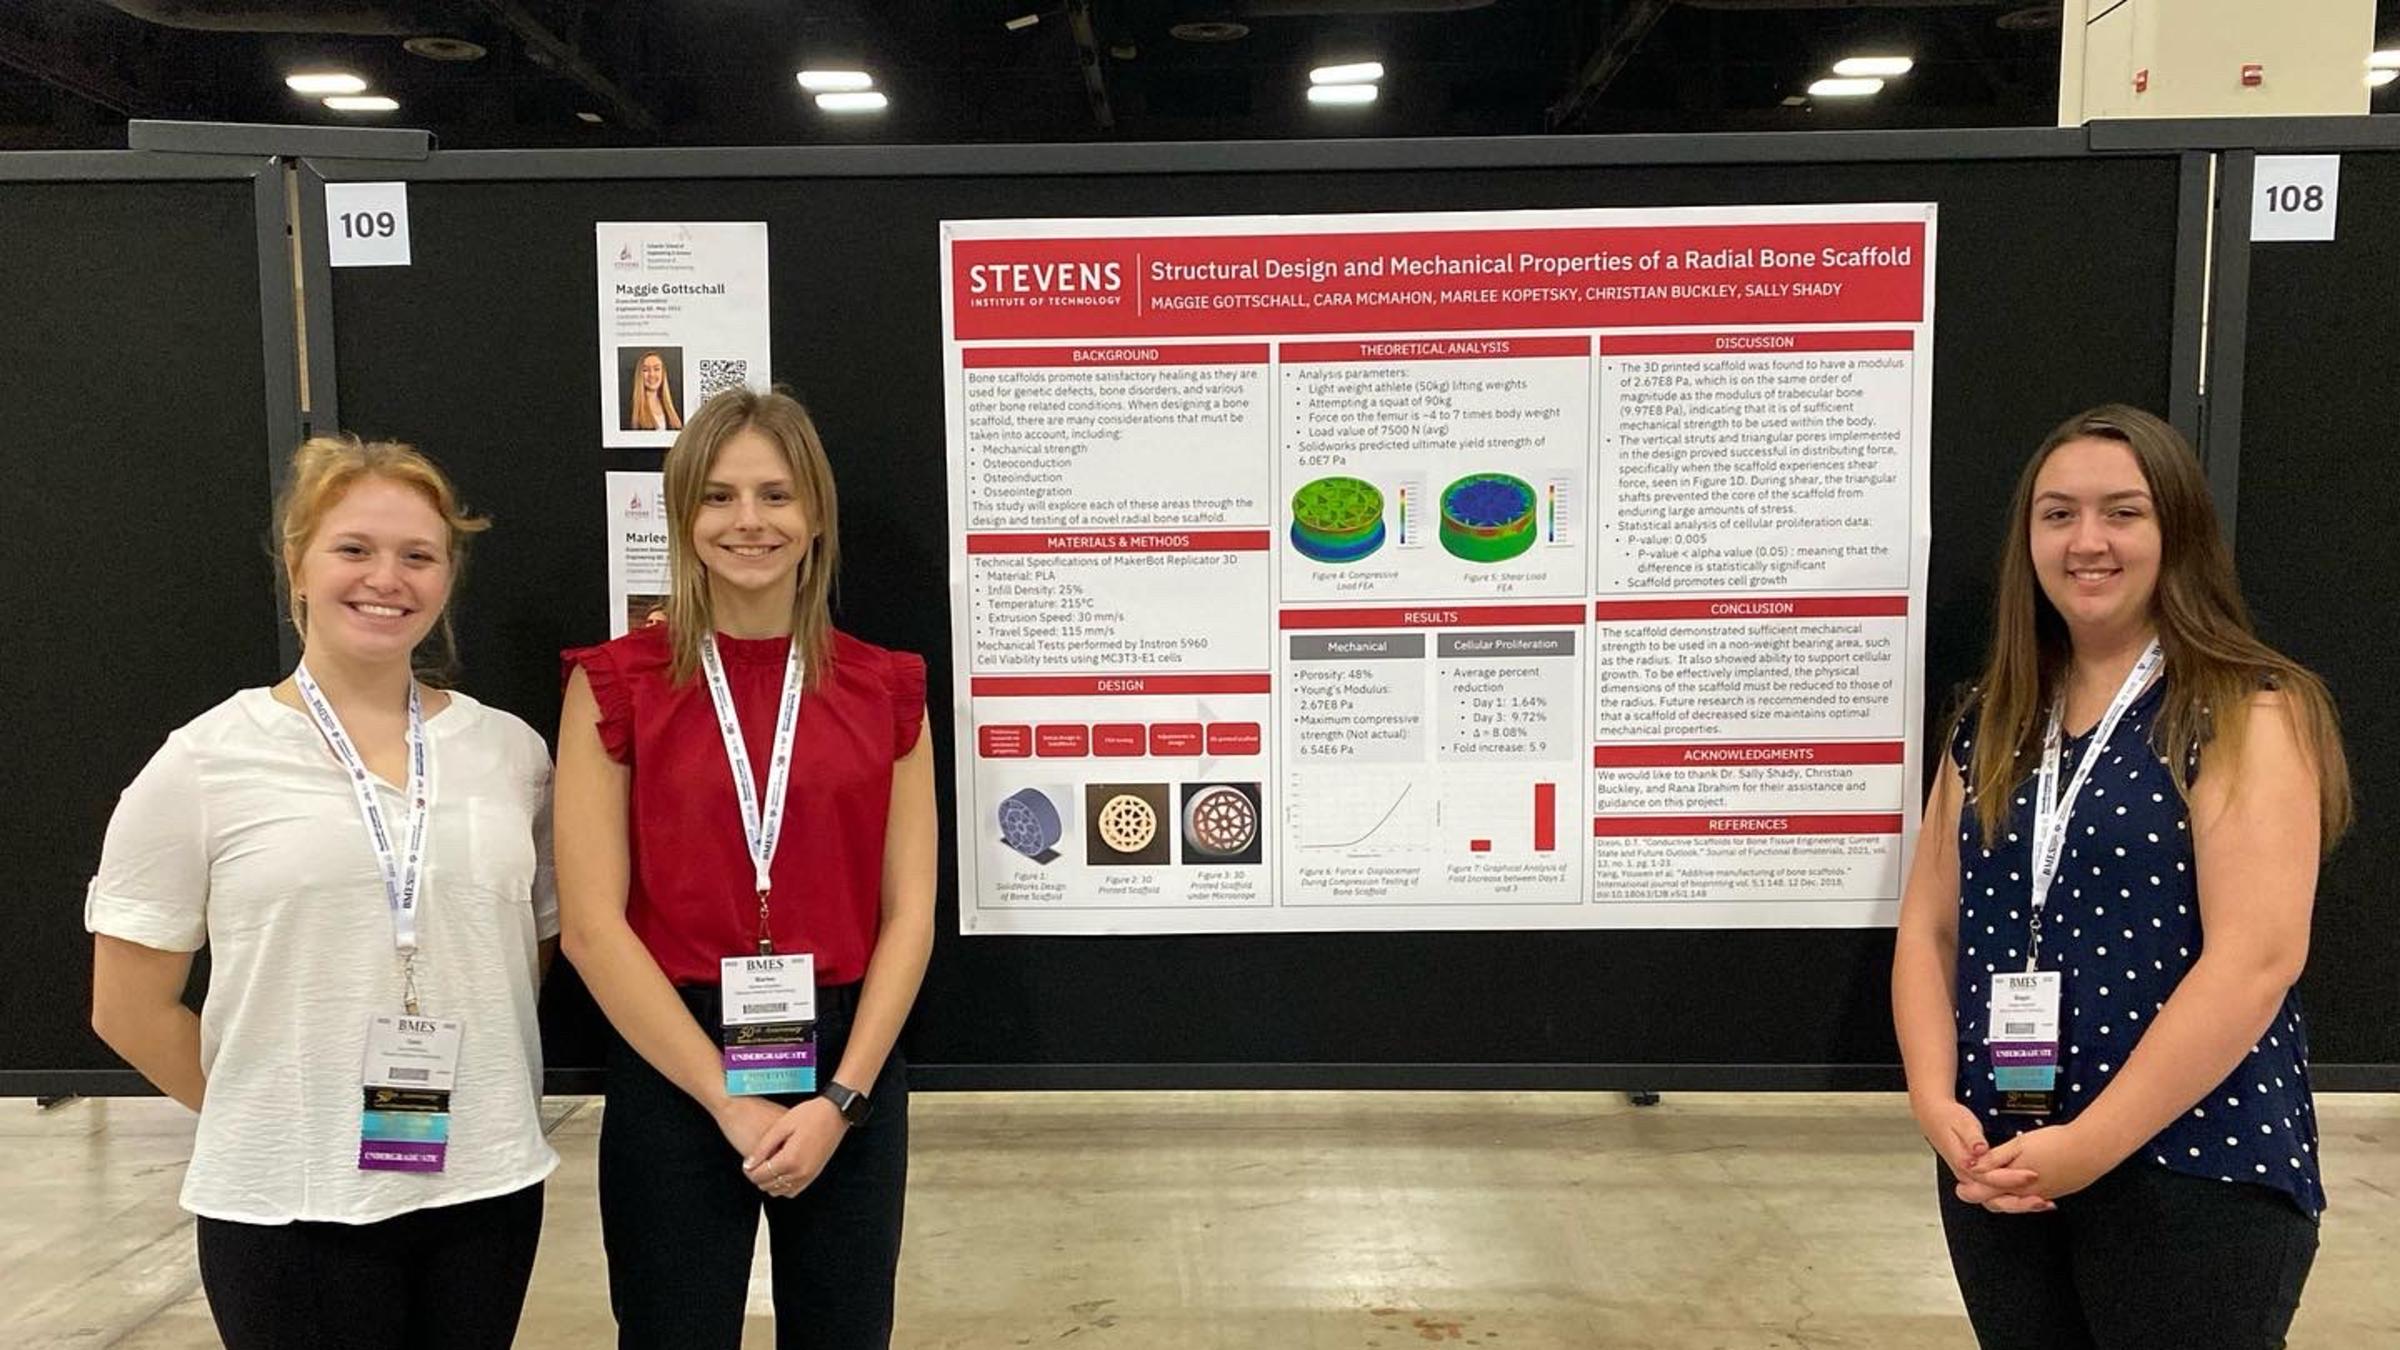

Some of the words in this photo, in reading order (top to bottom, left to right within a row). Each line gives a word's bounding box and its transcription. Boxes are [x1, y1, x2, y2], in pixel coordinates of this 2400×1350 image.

[2266, 185, 2323, 212] 108
[340, 211, 395, 238] 109
[1151, 260, 1258, 281] Structural
[1265, 258, 1337, 284] Design
[1344, 257, 1384, 276] and
[1391, 254, 1512, 275] Mechanical
[1520, 252, 1632, 278] Properties
[1639, 251, 1660, 270] of
[1666, 255, 1678, 269] a
[1685, 249, 1753, 269] Radial
[1760, 247, 1815, 267] Bone
[1822, 245, 1911, 266] Scaffold
[971, 261, 1120, 294] STEVENS
[616, 283, 659, 297] Maggie
[662, 283, 725, 294] Gottschall
[971, 297, 1025, 307] INSTITUTE
[1029, 297, 1044, 306] OF
[1049, 296, 1121, 306] TECHNOLOGY
[1151, 295, 1209, 309] MAGGIE
[1213, 293, 1311, 310] GOTTSCHALL,
[1313, 292, 1352, 306] CARA
[1356, 290, 1437, 308] MCMAHON,
[1440, 289, 1498, 304] MARLEE
[1502, 288, 1583, 305] KOPETSKY,
[1586, 286, 1668, 301] CHRISTIAN
[1671, 285, 1742, 302] BUCKLEY,
[1745, 284, 1788, 298] SALLY
[1792, 283, 1842, 297] SHADY
[1361, 344, 1443, 355] THEORETICAL
[1448, 342, 1510, 353] ANALYSIS
[1715, 337, 1794, 348] DISCUSSION
[1073, 350, 1159, 361] BACKGROUND
[1299, 369, 1343, 381] Analysis
[1345, 368, 1410, 381] parameters:
[1308, 383, 1334, 395] Light
[1337, 382, 1373, 395] weight
[1374, 382, 1413, 392] athlete
[1415, 381, 1450, 394] (50kg)
[1452, 381, 1483, 393] lifting
[1485, 380, 1527, 392] weights
[982, 444, 1042, 454] Mechanical
[1044, 444, 1088, 456] strength
[982, 458, 1072, 468] Osteoconduction
[1332, 455, 1346, 465] Pa
[983, 472, 1063, 482] Osteoinduction
[983, 486, 1072, 499] Osseointegration
[625, 532, 667, 543] Marlee
[1047, 537, 1116, 548] MATERIALS
[1119, 537, 1128, 547] &
[1130, 536, 1189, 547] METHODS
[1628, 534, 1673, 544] P-value:
[1674, 534, 1707, 544] 0.005
[975, 557, 1025, 567] Technical
[1026, 556, 1099, 569] Specifications
[1101, 556, 1112, 566] of
[1114, 556, 1165, 566] MakerBot
[1166, 555, 1220, 568] Replicator
[1223, 555, 1238, 565] 3D
[986, 571, 1033, 580] Material:
[1035, 570, 1056, 580] PLA
[1627, 577, 1672, 587] Scaffold
[1673, 576, 1726, 589] promotes
[1728, 576, 1748, 586] cell
[1749, 575, 1788, 588] growth
[987, 585, 1012, 594] Infill
[1014, 585, 1057, 597] Density:
[1059, 585, 1084, 594] 25%
[988, 599, 1058, 611] Temperature:
[1711, 603, 1794, 614] CONCLUSION
[988, 612, 1037, 622] Extrusion
[1039, 612, 1076, 624] Speed:
[1078, 612, 1092, 622] 30
[1094, 612, 1124, 624] mm/s
[1404, 612, 1458, 623] RESULTS
[988, 626, 1021, 636] Travel
[1023, 626, 1059, 638] Speed:
[1062, 626, 1082, 636] 115
[1084, 626, 1115, 638] mm/s
[1602, 627, 1622, 637] The
[1624, 626, 1668, 636] scaffold
[1669, 625, 1746, 636] demonstrated
[1748, 625, 1798, 635] sufficient
[1800, 624, 1863, 634] mechanical
[977, 640, 1036, 650] Mechanical
[1038, 640, 1066, 650] Tests
[1068, 640, 1123, 652] performed
[1124, 639, 1137, 651] by
[1140, 639, 1178, 649] Instron
[1180, 639, 1208, 648] 5960
[1328, 641, 1387, 652] Mechanical
[1454, 639, 1493, 649] Cellular
[1495, 639, 1558, 649] Proliferation
[977, 654, 998, 664] Cell
[999, 654, 1041, 666] Viability
[1042, 654, 1069, 663] tests
[1070, 654, 1099, 666] using
[1158, 653, 1182, 663] cells
[1300, 669, 1346, 682] Porosity:
[1348, 669, 1373, 679] 48%
[1453, 667, 1496, 680] Average
[1498, 667, 1540, 679] percent
[1098, 681, 1144, 691] DESIGN
[1343, 684, 1391, 694] Modulus:
[1453, 682, 1504, 692] reduction
[1340, 699, 1354, 709] Pa
[1473, 697, 1494, 710] Day
[1496, 697, 1507, 707] 1:
[1512, 697, 1547, 707] 1.64%
[1300, 714, 1351, 724] Maximum
[1353, 714, 1420, 727] compressive
[1473, 712, 1493, 724] Day
[1496, 712, 1507, 721] 3:
[1511, 712, 1547, 721] 9.72%
[1300, 729, 1344, 742] strength
[1346, 729, 1369, 742] (Not
[1492, 728, 1528, 738] 8.08%
[1600, 724, 1662, 734] mechanical
[1663, 724, 1722, 737] properties.
[1340, 744, 1354, 754] Pa
[1453, 742, 1477, 752] Fold
[1478, 742, 1527, 752] increase:
[1529, 742, 1546, 752] 5.9
[1684, 749, 1814, 760] ACKNOWLEDGMENTS
[1597, 770, 1615, 780] We
[1618, 769, 1650, 779] would
[1652, 769, 1672, 779] like
[1674, 769, 1686, 779] to
[1688, 769, 1718, 779] thank
[1720, 769, 1734, 778] Dr.
[1738, 768, 1764, 781] Sally
[1766, 768, 1803, 781] Shady,
[1805, 768, 1854, 778] Christian
[1709, 819, 1788, 830] REFERENCES
[746, 959, 785, 971] BMES
[2009, 977, 2038, 988] BMES
[398, 1019, 437, 1033] BMES
[731, 1051, 809, 1062] UNDERGRADUATE
